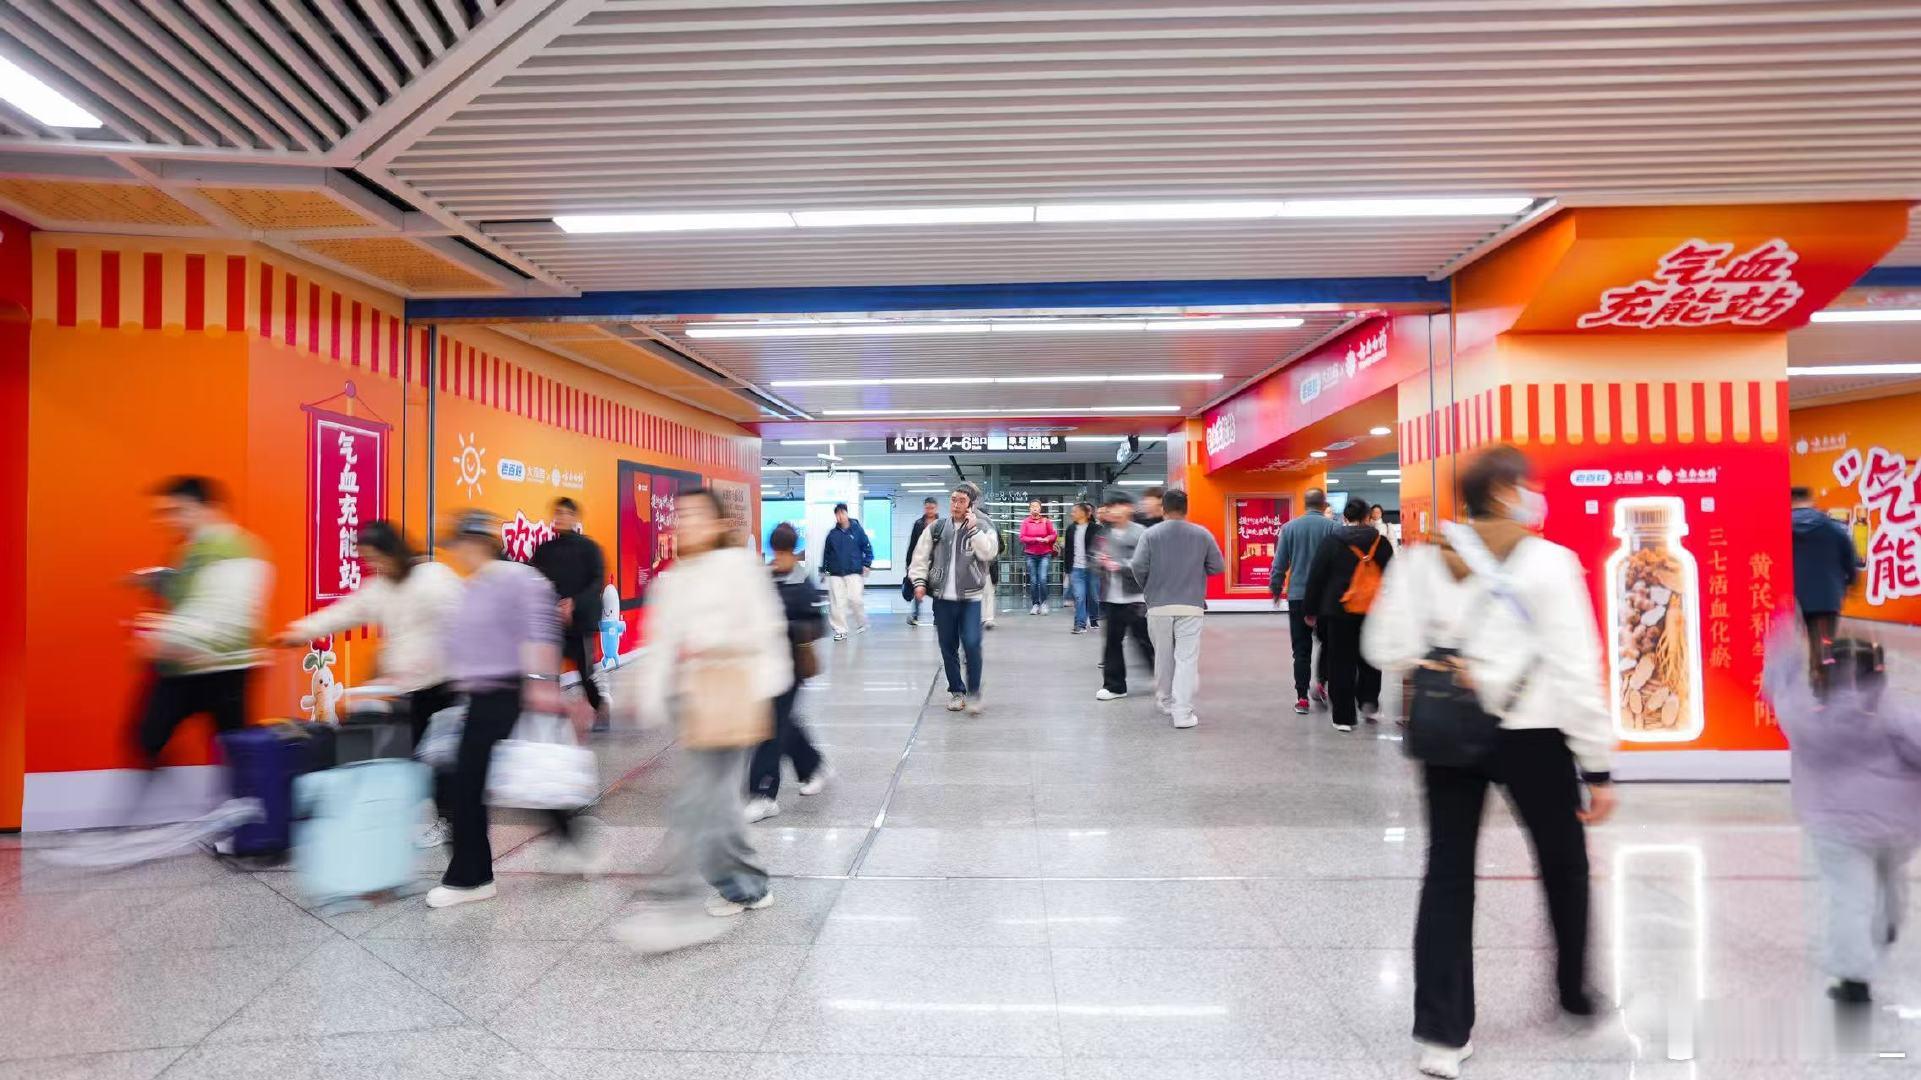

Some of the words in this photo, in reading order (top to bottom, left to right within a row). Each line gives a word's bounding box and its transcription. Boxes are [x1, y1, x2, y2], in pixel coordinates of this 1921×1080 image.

[1656, 240, 1797, 285] 气血
[1578, 281, 1802, 328] 充能站
[337, 431, 361, 590] 气血充能站
